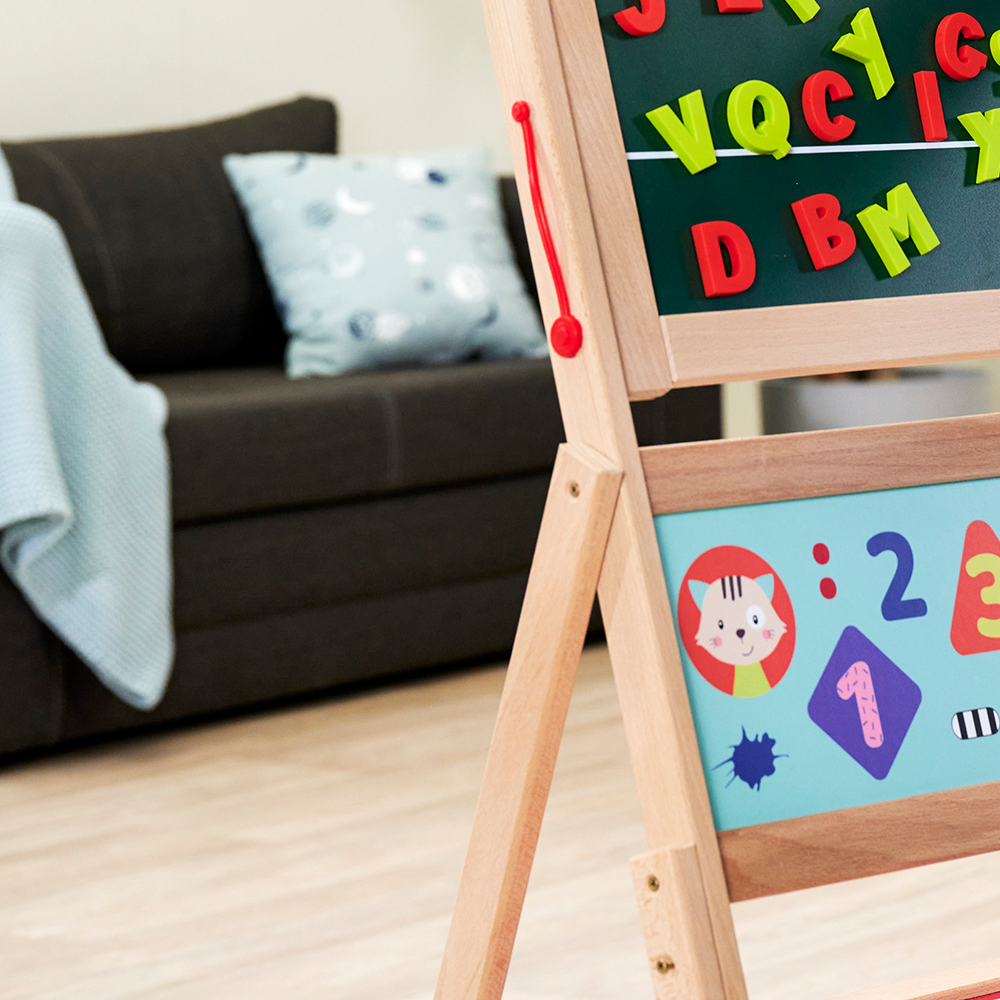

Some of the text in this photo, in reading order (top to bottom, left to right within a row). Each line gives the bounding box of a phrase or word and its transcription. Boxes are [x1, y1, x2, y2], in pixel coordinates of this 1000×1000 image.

[645, 88, 718, 175] V
[726, 79, 792, 161] Q
[801, 69, 856, 143] C
[690, 220, 757, 298] D
[790, 192, 857, 271] B
[855, 181, 941, 278] M
[866, 531, 928, 622] 2
[836, 660, 884, 749] 1
